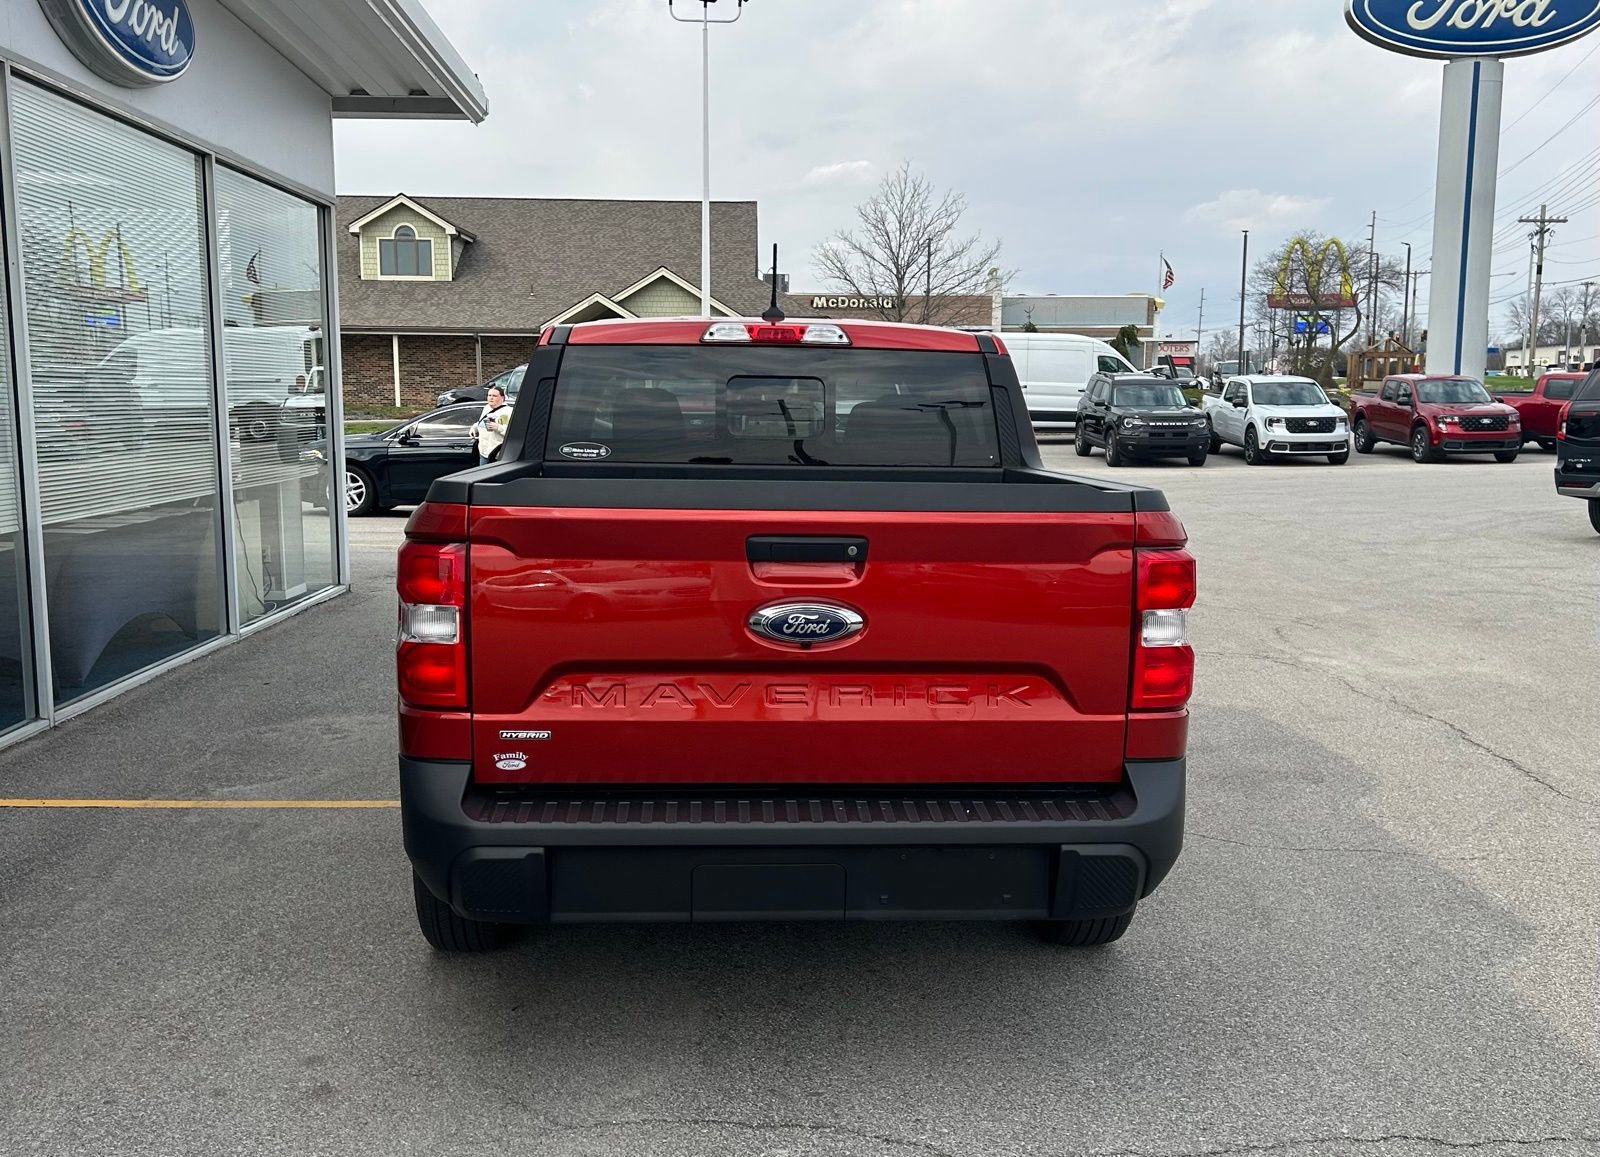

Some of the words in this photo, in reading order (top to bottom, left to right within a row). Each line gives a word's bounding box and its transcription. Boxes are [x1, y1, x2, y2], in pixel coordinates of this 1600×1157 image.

[813, 296, 897, 308] McDonald
[783, 613, 831, 634] Ford
[570, 682, 1033, 710] MAVERICK
[493, 751, 529, 761] Family
